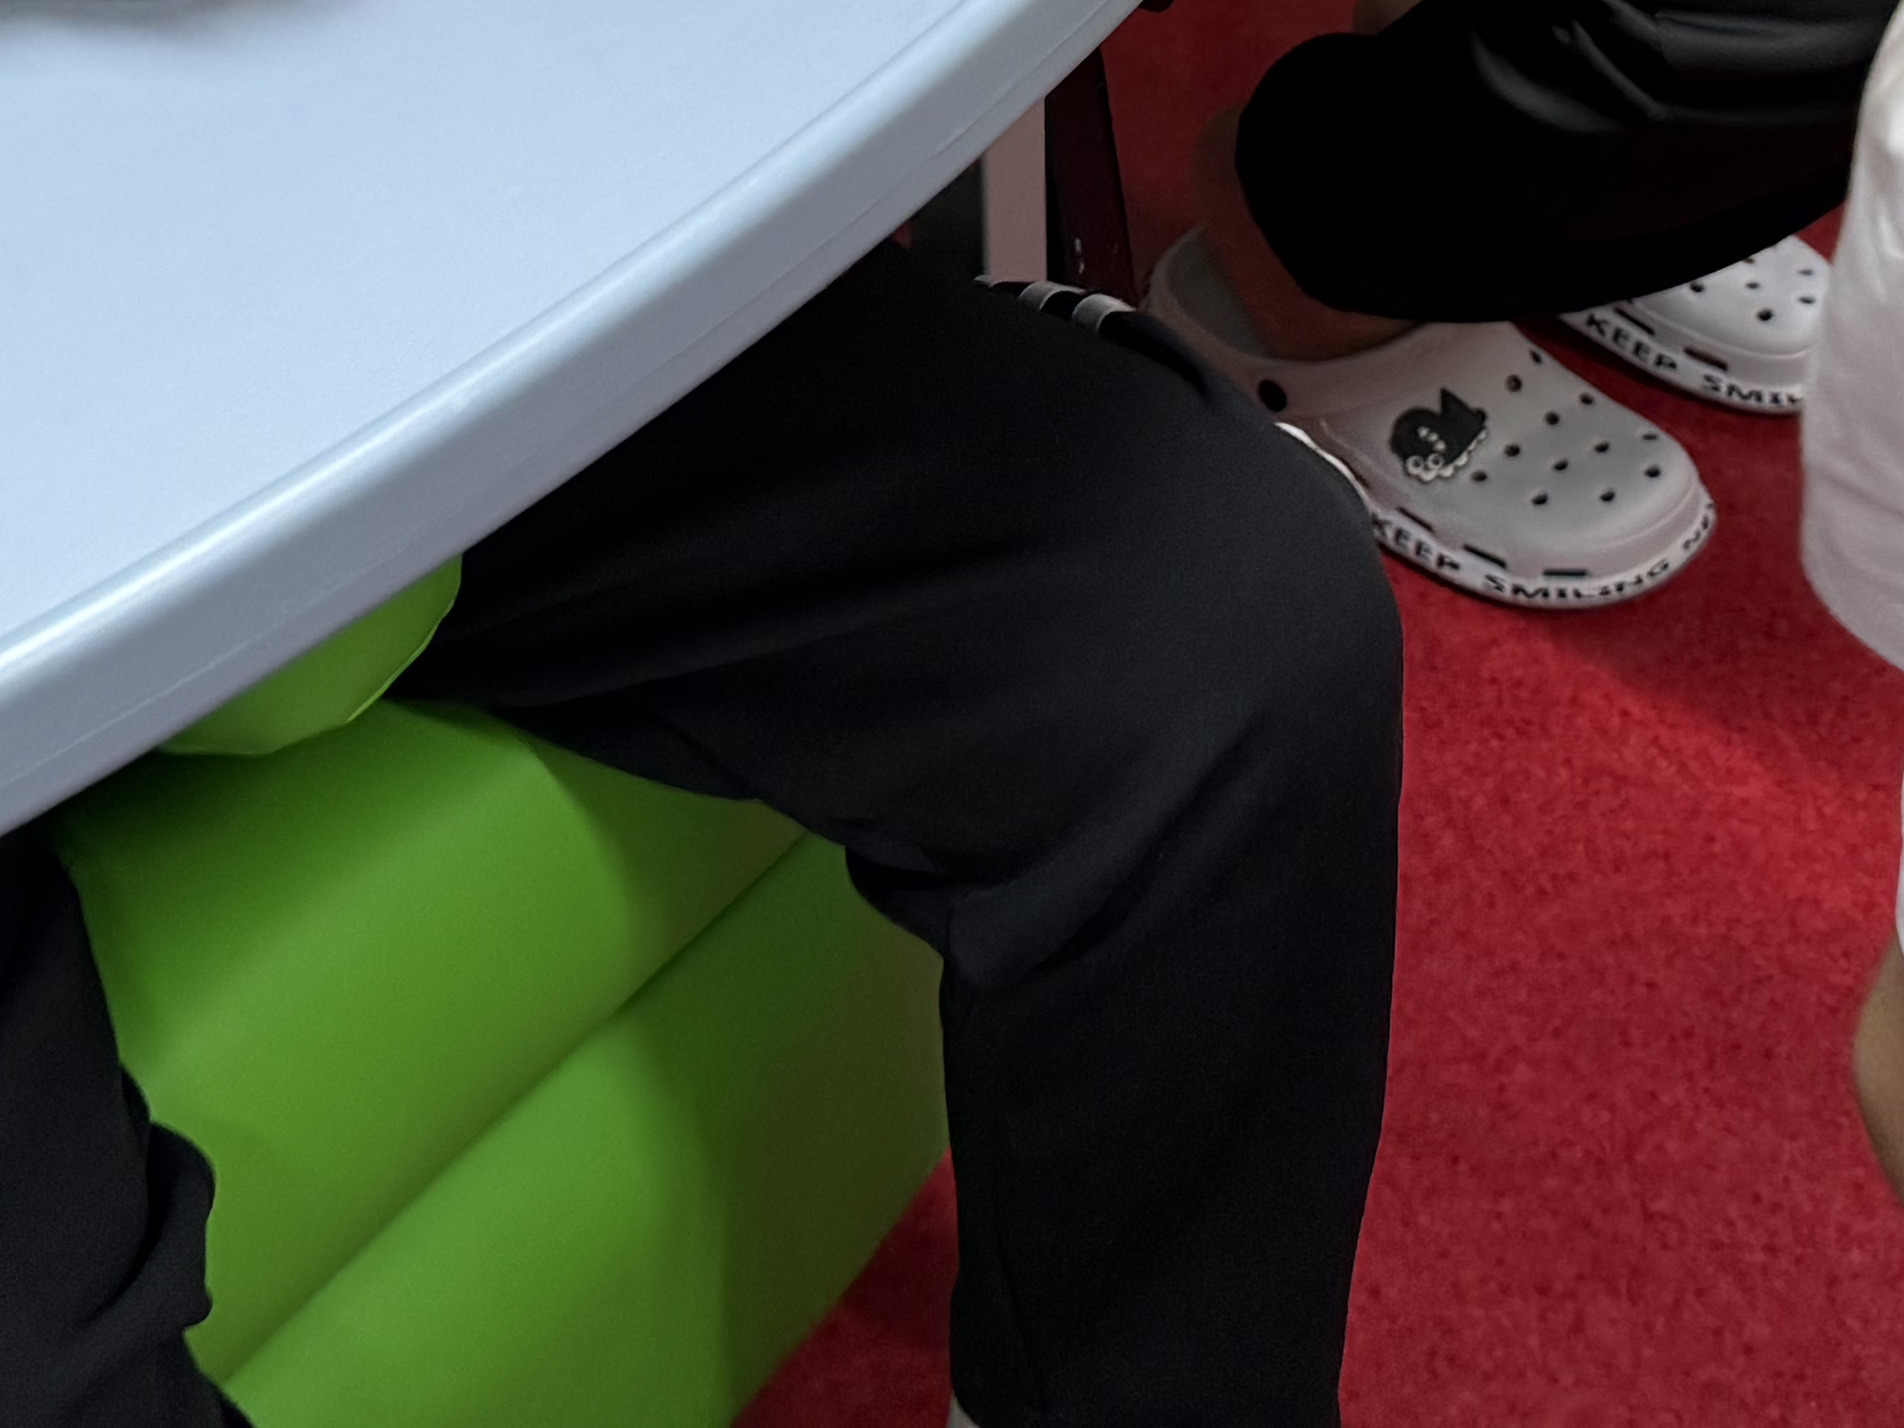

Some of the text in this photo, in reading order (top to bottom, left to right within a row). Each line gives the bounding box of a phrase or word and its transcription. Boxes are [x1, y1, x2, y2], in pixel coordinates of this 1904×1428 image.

[1585, 313, 1678, 370] KEEP
[1371, 512, 1670, 598] KEEP SMILING
